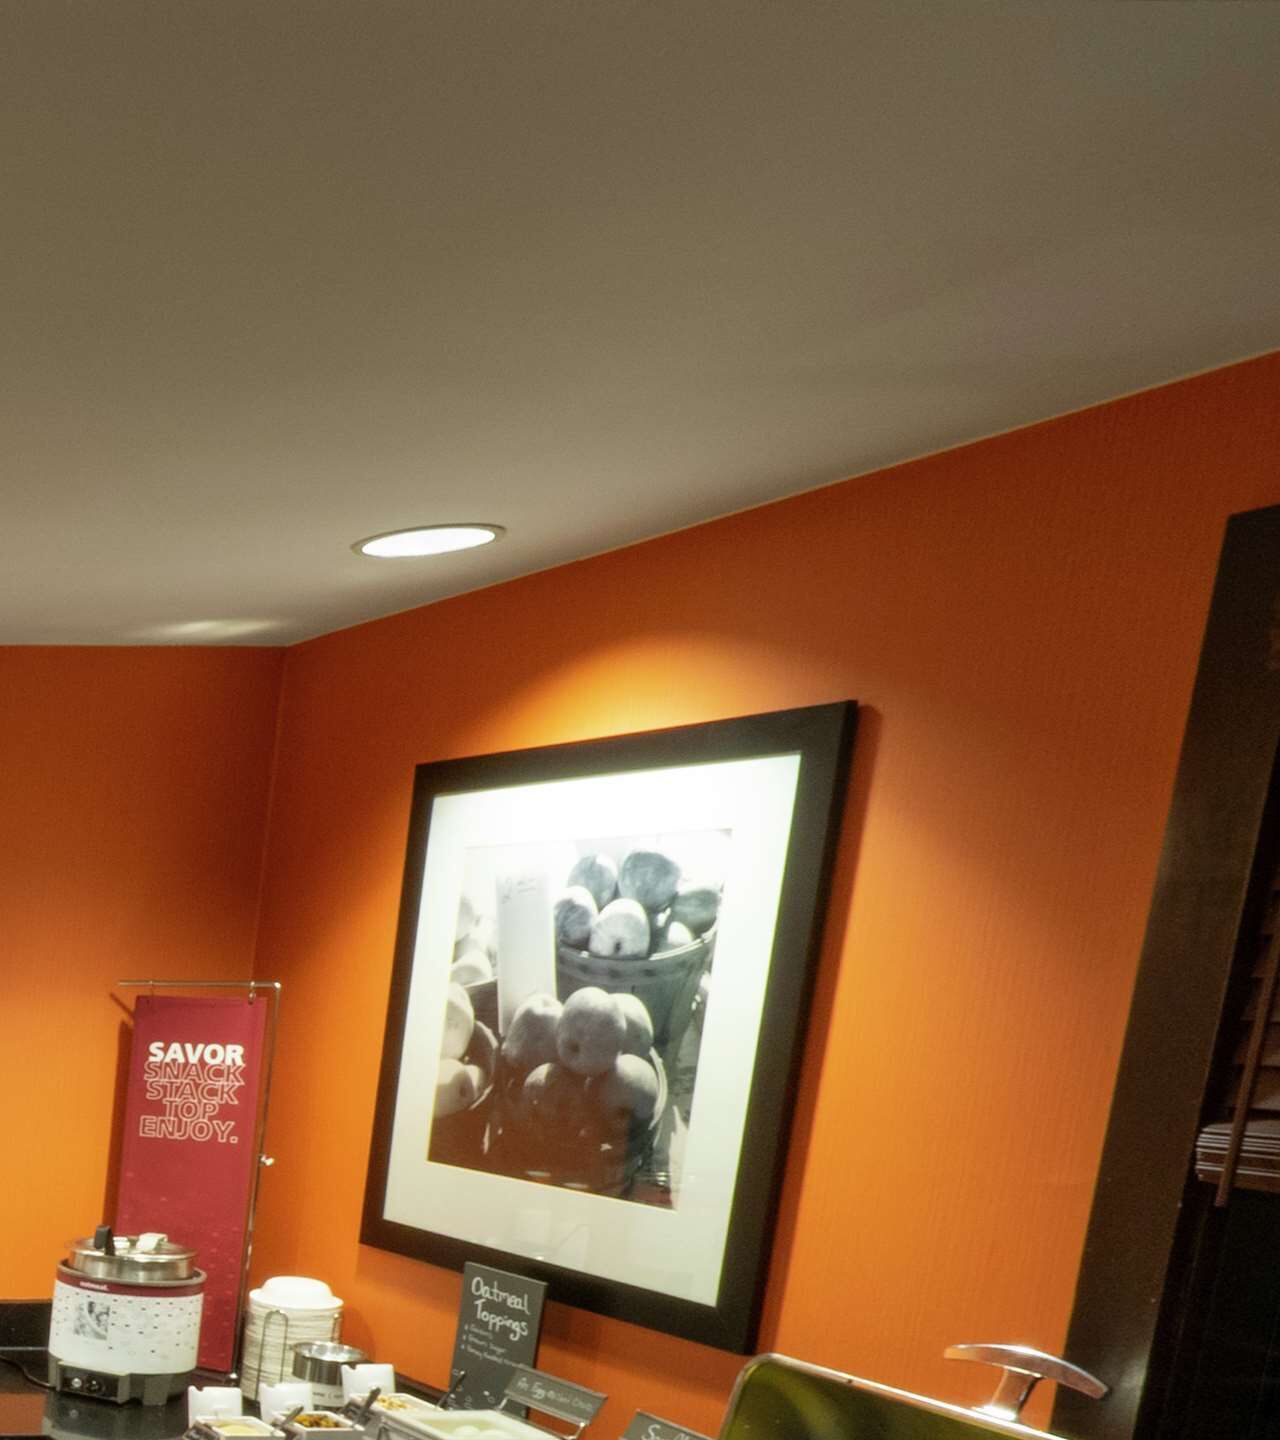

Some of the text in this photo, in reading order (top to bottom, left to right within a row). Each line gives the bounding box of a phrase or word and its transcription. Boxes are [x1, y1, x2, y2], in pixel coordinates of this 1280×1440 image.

[148, 1041, 244, 1066] SAVOR
[144, 1061, 246, 1085] SNACK
[146, 1079, 239, 1104] STACK
[162, 1098, 219, 1121] TOP
[140, 1115, 239, 1144] ENJOY.
[471, 1276, 530, 1315] Oatmeal
[474, 1298, 528, 1341] Toppings
